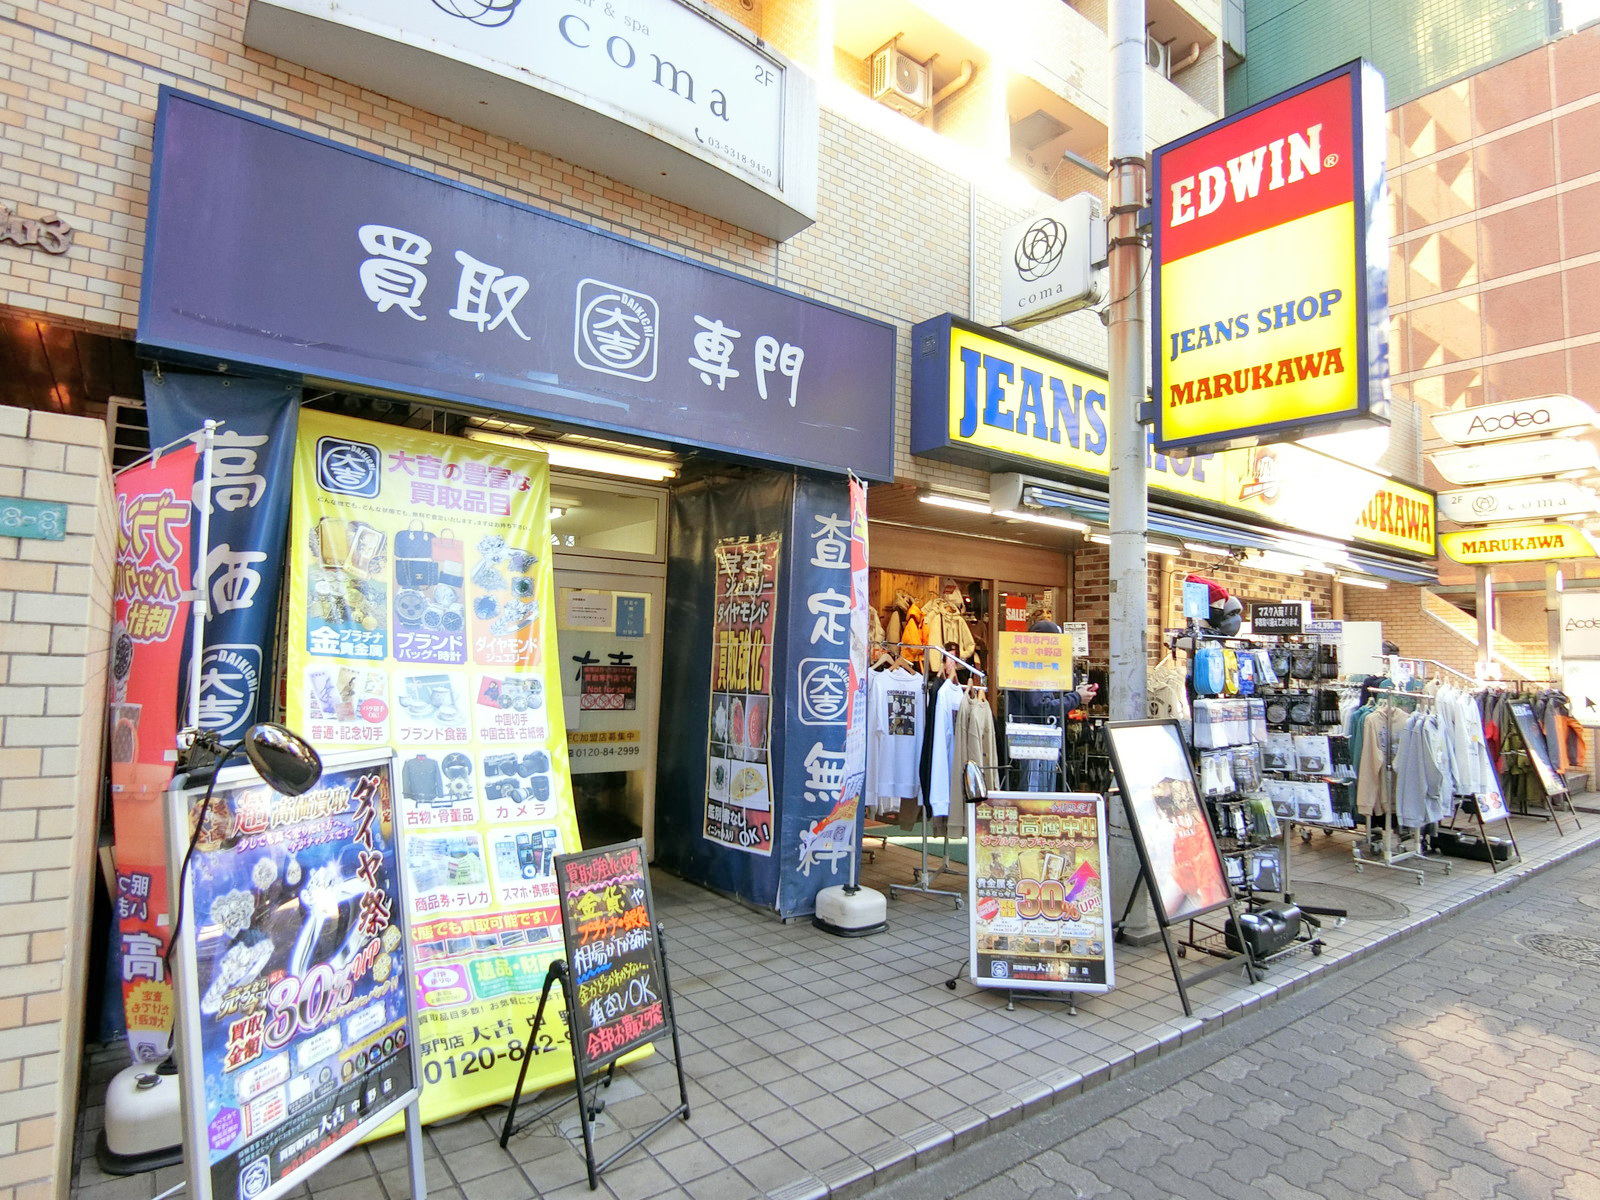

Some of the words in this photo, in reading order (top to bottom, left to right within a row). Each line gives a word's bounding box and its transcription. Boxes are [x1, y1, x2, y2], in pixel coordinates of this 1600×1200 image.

[624, 16, 650, 36] spa
[559, 14, 729, 122] coma
[754, 64, 775, 87] 2F
[707, 136, 772, 178] 03-5318-9450
[1170, 123, 1324, 227] EDWIN
[1018, 283, 1064, 308] coma
[358, 224, 532, 341] 買取
[688, 314, 805, 408] 専門
[620, 292, 654, 338] DAIKICHI
[1170, 315, 1250, 363] JEANS
[1257, 288, 1342, 335] SHOP
[592, 306, 642, 361] 大吉
[1170, 347, 1345, 408] MARUKAWA
[959, 346, 1108, 457] JEANS
[351, 445, 376, 471] DAIKICHI
[388, 450, 532, 492] 大吉の豊富な
[410, 481, 512, 516] 買取品目
[1451, 496, 1463, 505] 2F
[1508, 496, 1567, 511] coma
[1461, 534, 1565, 554] MARUKAWA
[807, 513, 851, 645] 査定
[717, 601, 768, 624] ダイヤモンド
[1006, 608, 1027, 621] SALE!
[310, 626, 341, 655] 金
[340, 629, 384, 642] プラチナ
[396, 633, 464, 650] ブランド
[475, 636, 538, 653] ダイヤモンド
[1014, 634, 1059, 646] 買取専門店
[340, 642, 384, 658] 貴金属
[398, 650, 462, 663] バッグ・時計
[485, 653, 530, 663] ジュエリー
[717, 629, 765, 692] 買取強化
[1035, 647, 1062, 657] 中野店
[218, 650, 257, 692] DAIKICHI
[587, 685, 602, 693] Not
[603, 685, 614, 693] for
[809, 674, 845, 713] 大吉
[495, 713, 529, 727] 中国切手
[311, 725, 384, 741] 普通・記念切手
[400, 727, 468, 742] ブランド食器
[480, 726, 545, 741] 中国古銭・古紙幣
[576, 746, 640, 758] 0120-84-2999
[406, 807, 474, 826] 古物・骨董品
[496, 803, 547, 819] カメラ
[738, 822, 771, 847] OK!
[352, 773, 391, 936] ダイヤ祭
[415, 891, 489, 913] 商品券・テレカ
[1016, 879, 1081, 921] 30%
[471, 1017, 514, 1045] 大吉
